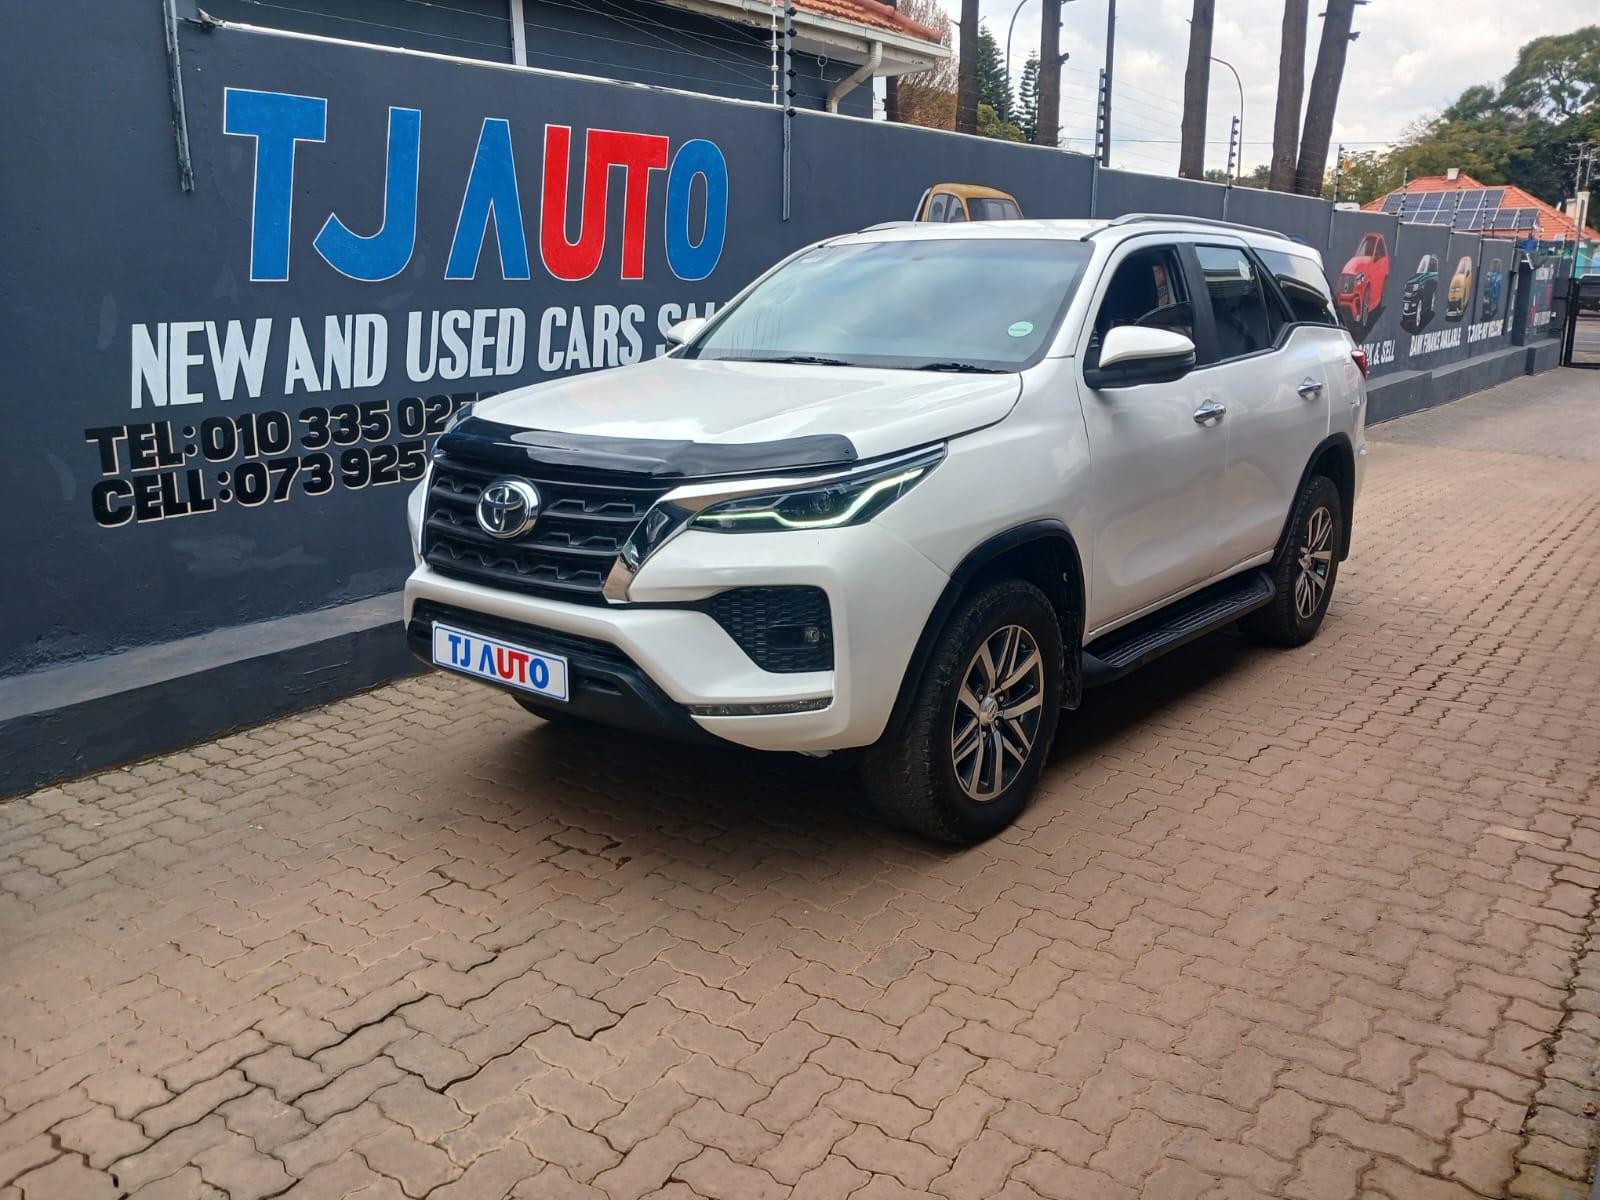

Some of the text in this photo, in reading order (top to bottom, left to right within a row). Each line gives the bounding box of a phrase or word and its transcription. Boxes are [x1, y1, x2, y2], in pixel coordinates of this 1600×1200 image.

[223, 86, 729, 283] TJ AUTO
[131, 318, 273, 409] NEW
[284, 313, 389, 395] AND
[406, 307, 527, 381] USED
[538, 304, 646, 373] CARS
[300, 399, 392, 448] 335
[397, 391, 501, 438] 02
[340, 440, 427, 489] 925
[448, 634, 549, 689] TJ AUTO
